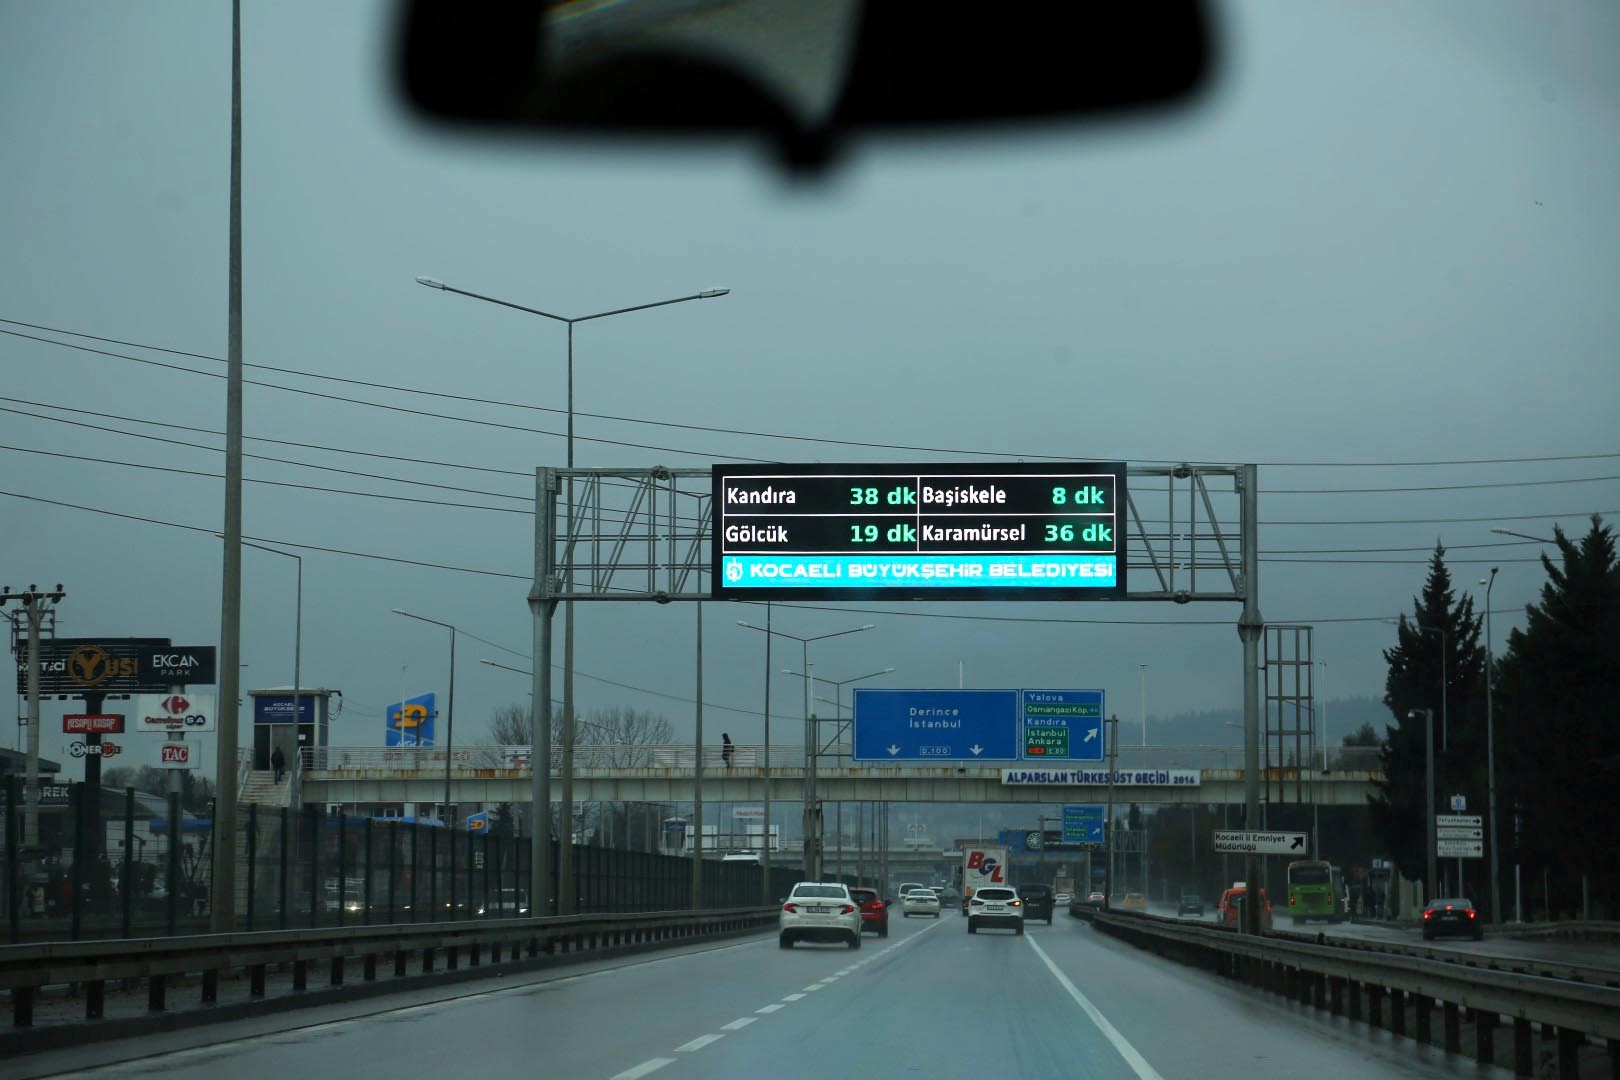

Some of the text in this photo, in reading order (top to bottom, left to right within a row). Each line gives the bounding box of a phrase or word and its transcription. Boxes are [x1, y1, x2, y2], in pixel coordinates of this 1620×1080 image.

[728, 486, 917, 505] Kandıra 38 dk
[923, 485, 1105, 507] Başiskele 8 dk
[726, 523, 917, 543] Gölcük 19 dk
[923, 523, 1113, 543] Karamürsel 36 dk
[751, 563, 841, 578] KOCAELİ
[849, 563, 983, 579] BÜYÜKŞEHİR
[153, 654, 199, 667] EKCAN
[1029, 693, 1064, 702] Yalova
[909, 707, 959, 717] Derince
[1027, 705, 1072, 714] Osmangazi
[909, 717, 961, 728] İstanbul
[1027, 718, 1067, 726] Kandıra
[1027, 728, 1066, 737] İstanbul
[1028, 737, 1062, 745] Ankara
[1007, 772, 1068, 783] ALPARSLAN
[1070, 770, 1110, 784] TÜRKEŞ
[1113, 771, 1133, 783] ÜST
[1215, 833, 1244, 842] Kocaeli
[1252, 834, 1285, 844] Emniyet
[967, 851, 1003, 883] BGL
